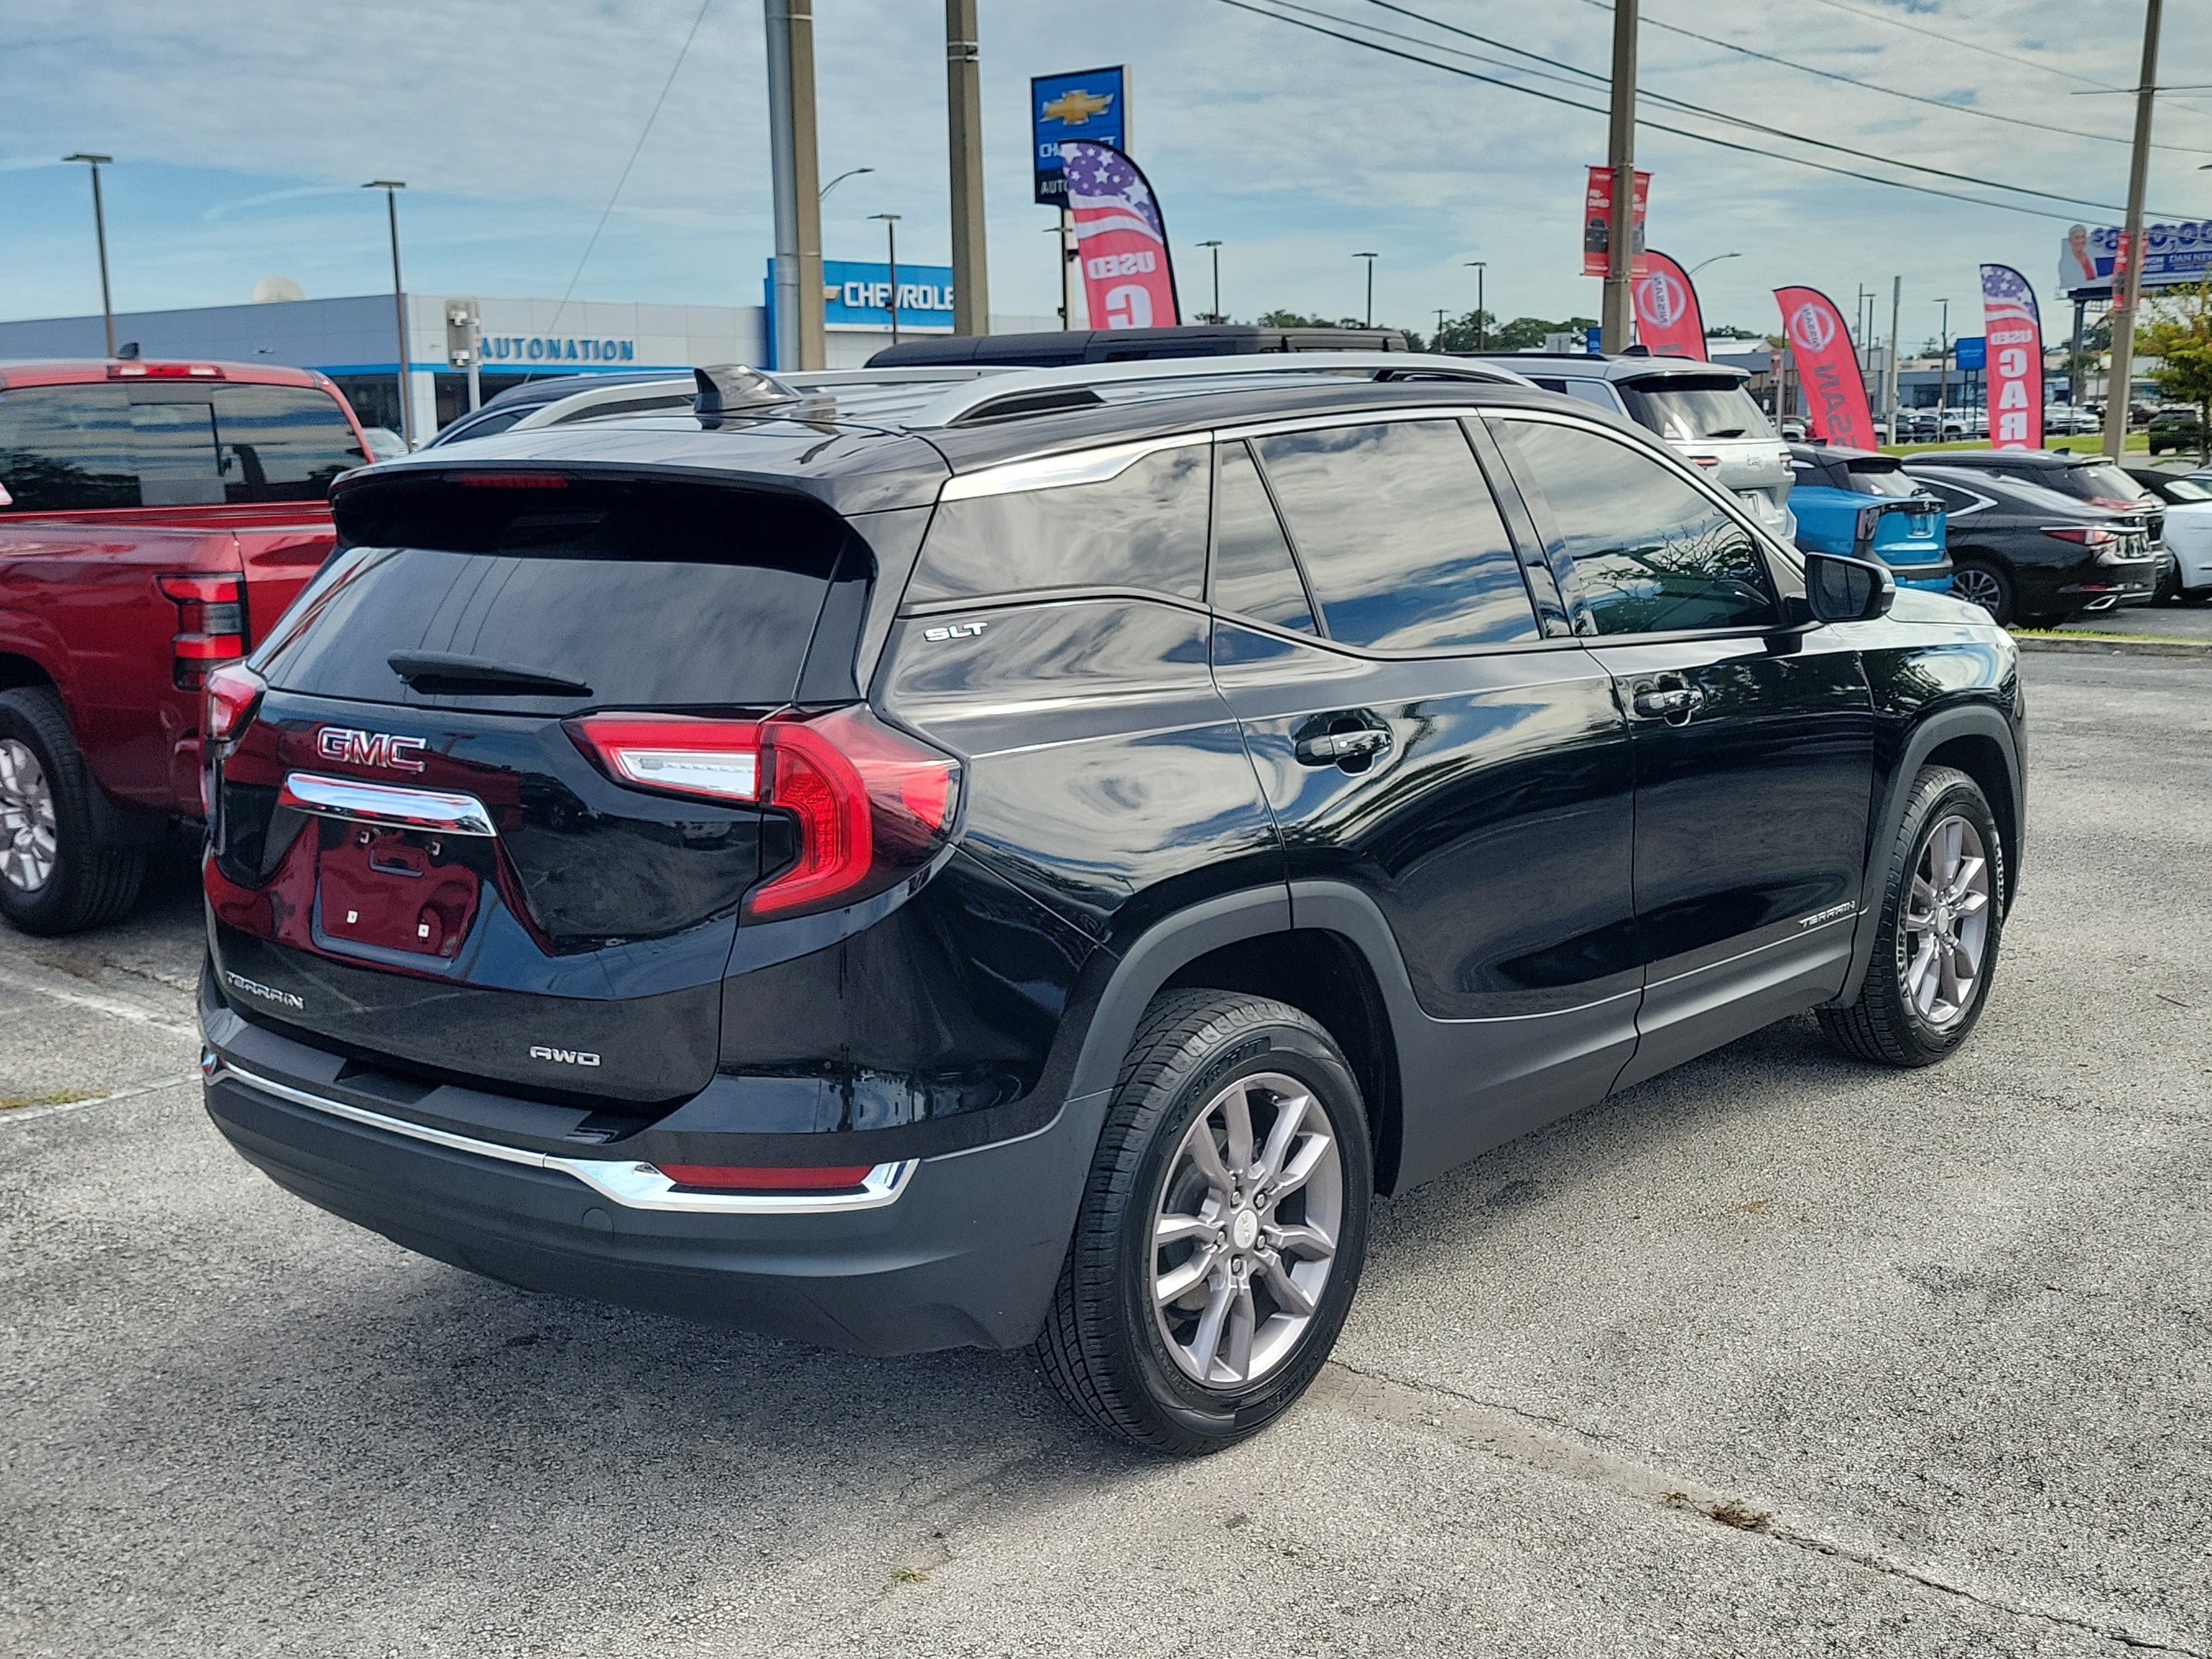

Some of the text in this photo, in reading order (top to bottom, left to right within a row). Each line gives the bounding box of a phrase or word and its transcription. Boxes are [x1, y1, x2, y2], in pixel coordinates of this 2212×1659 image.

[843, 281, 954, 311] CHEVROLE
[481, 336, 634, 361] AUTONATION
[924, 622, 989, 642] SLT
[317, 726, 426, 772] GMC
[1798, 900, 1855, 928] TERRAIN
[225, 970, 304, 1009] TERRAIN
[529, 1045, 601, 1066] AWD
